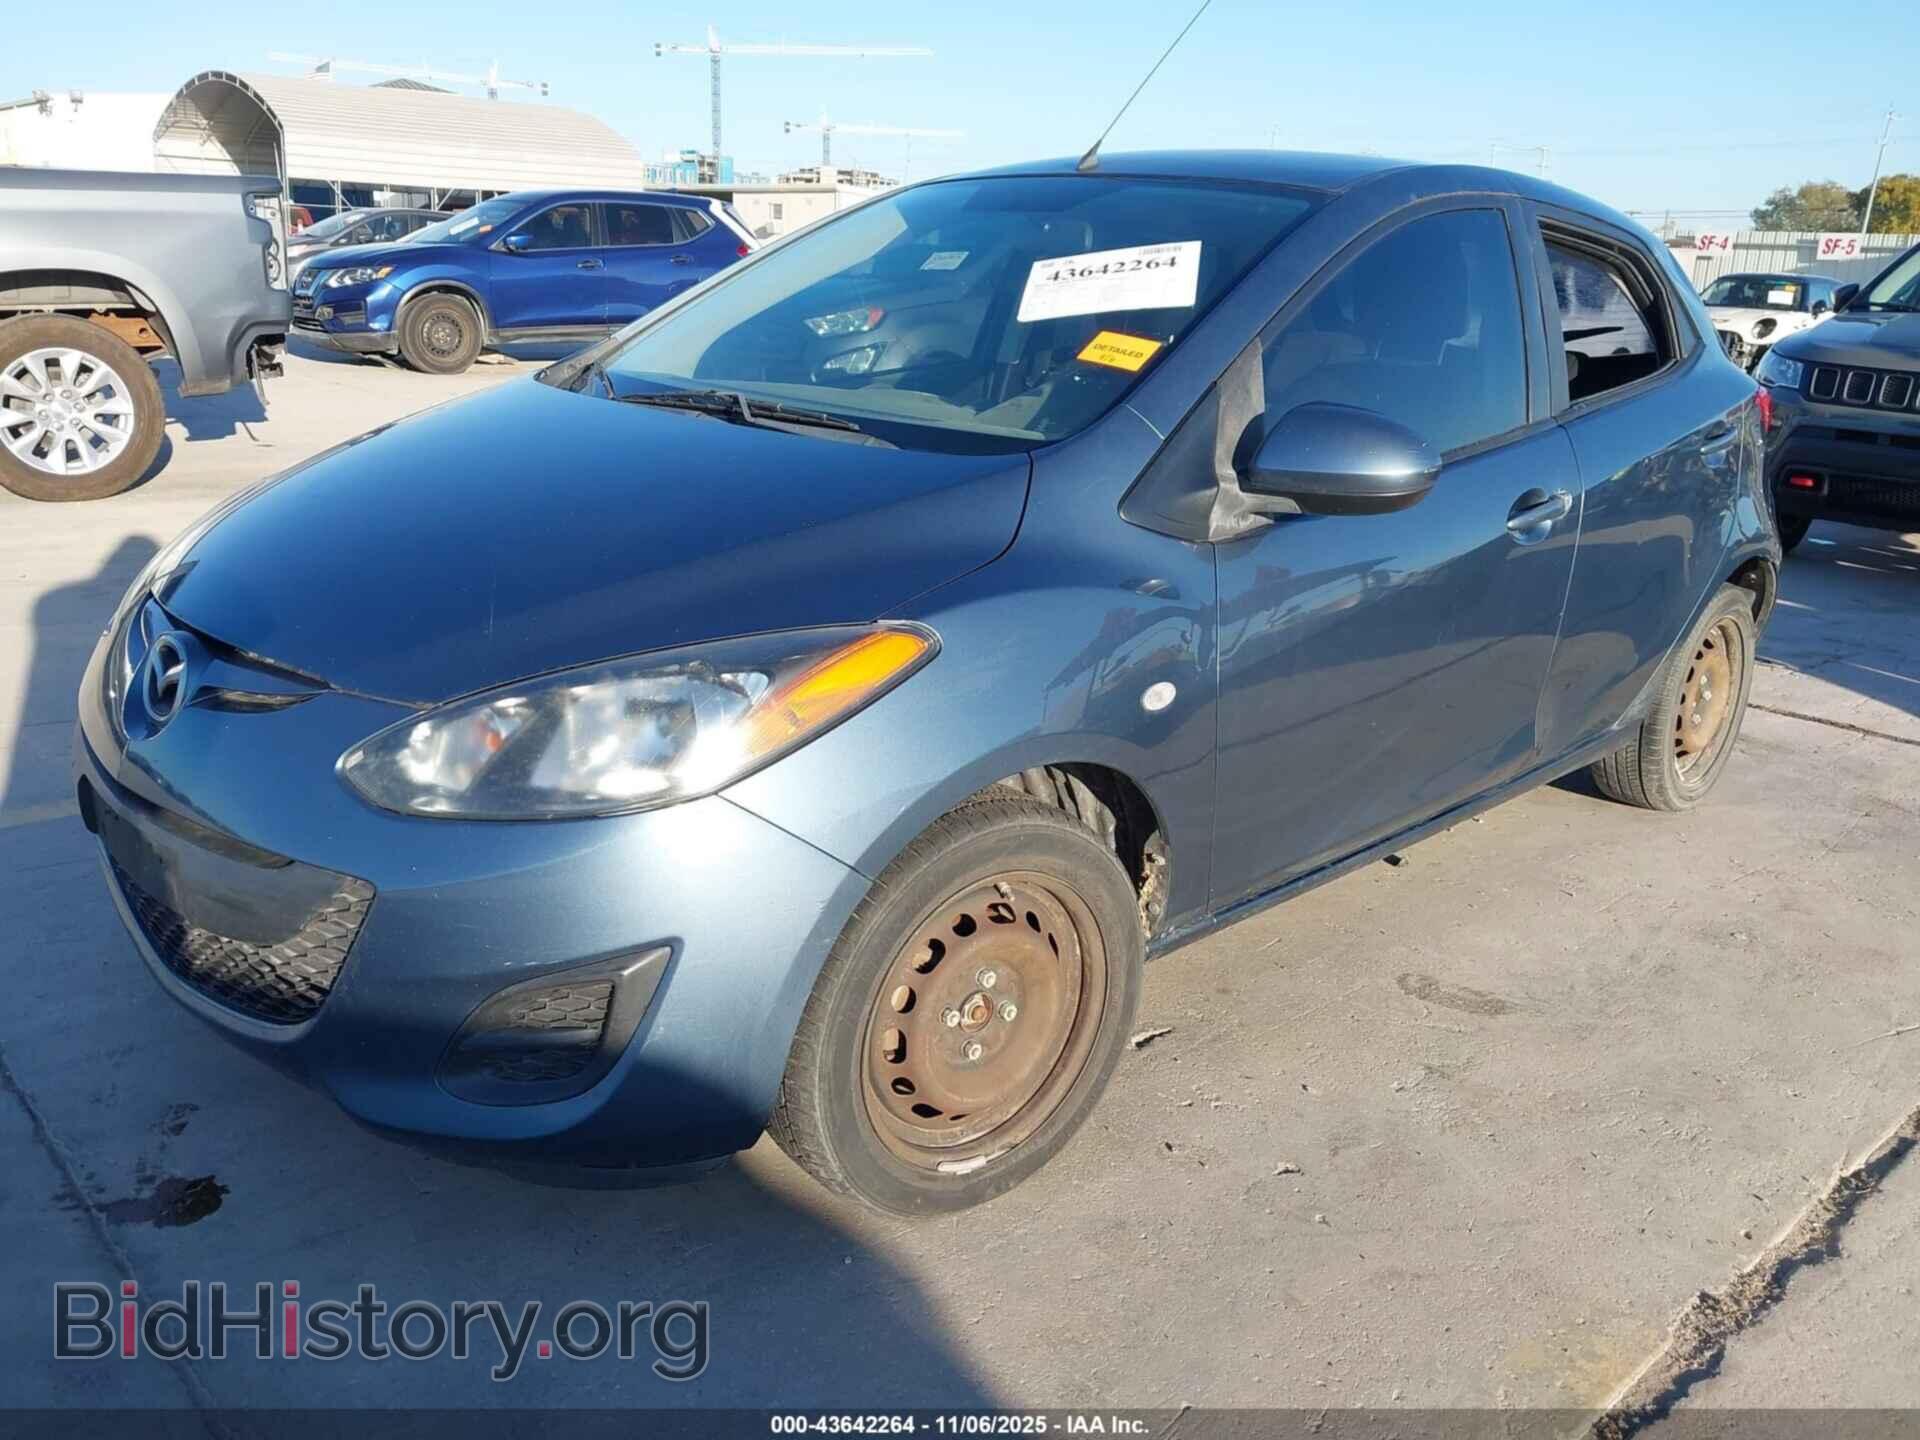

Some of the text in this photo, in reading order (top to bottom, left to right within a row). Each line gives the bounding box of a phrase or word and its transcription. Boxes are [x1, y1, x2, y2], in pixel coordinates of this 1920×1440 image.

[1698, 235, 1729, 251] SF-4
[1822, 238, 1857, 255] SF-5
[1046, 255, 1178, 282] 43642264
[1093, 343, 1144, 359] DETAILED
